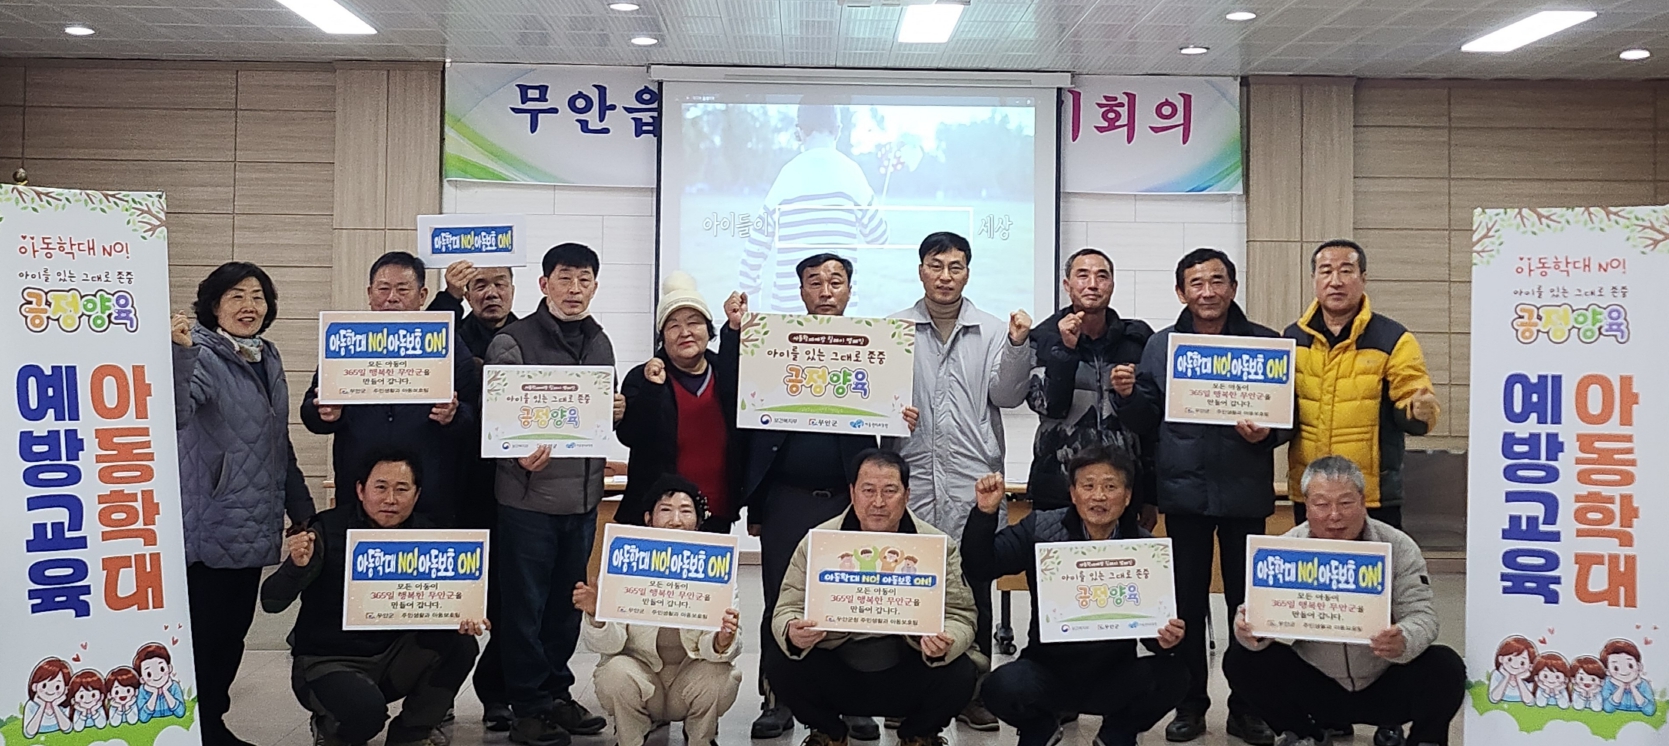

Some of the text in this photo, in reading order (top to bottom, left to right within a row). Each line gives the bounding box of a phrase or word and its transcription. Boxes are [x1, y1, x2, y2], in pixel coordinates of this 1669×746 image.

[509, 84, 658, 138] 무안읍
[703, 212, 1013, 240] 아이들이 세상
[19, 235, 130, 259] 아동학대 NO!
[434, 230, 511, 252] 아동학대 NO! 아동보호 ON!
[19, 268, 134, 284] 아이를 있는 그대로 존중
[1516, 256, 1626, 277] 아동학대 NO!
[1514, 285, 1628, 298] 아이를 있는 그대로 존중
[21, 289, 137, 331] 긍정양육
[1513, 304, 1629, 343] 긍정양육
[329, 328, 446, 356] 아동학대 NO! 아동보호 ON!
[767, 346, 886, 365] 아이를 있는 그대로 존중
[1177, 351, 1287, 381] 아동학대 NO! 아동보호 ON!
[784, 365, 869, 398] 긍정양육
[507, 393, 590, 404] 아이를 있는 그대로 존중
[519, 406, 579, 428] 긍정양육
[17, 364, 91, 618] 예방교육
[90, 364, 164, 611] 아동학대
[1501, 373, 1565, 604] 예방교육
[1574, 373, 1640, 608] 아동학대
[357, 547, 480, 578] 아동학대 NO! 아동보호 ON!
[613, 544, 730, 581] 아동학대 NO! 아동보호 ON!
[1257, 556, 1382, 591] 아동학대 NO! 아동보호 ON!
[824, 572, 932, 586] 아동학대 NO! 아동보호 ON!
[1062, 569, 1150, 582] 아이를 있는 그대로 존중
[398, 591, 424, 599] 행복한
[624, 587, 646, 595] 365일
[650, 589, 674, 598] 행복한
[642, 598, 664, 606] 만들어
[831, 595, 854, 603] 365일
[857, 596, 883, 605] 행복한
[1076, 584, 1140, 608] 긍정양육
[850, 606, 872, 614] 만들어
